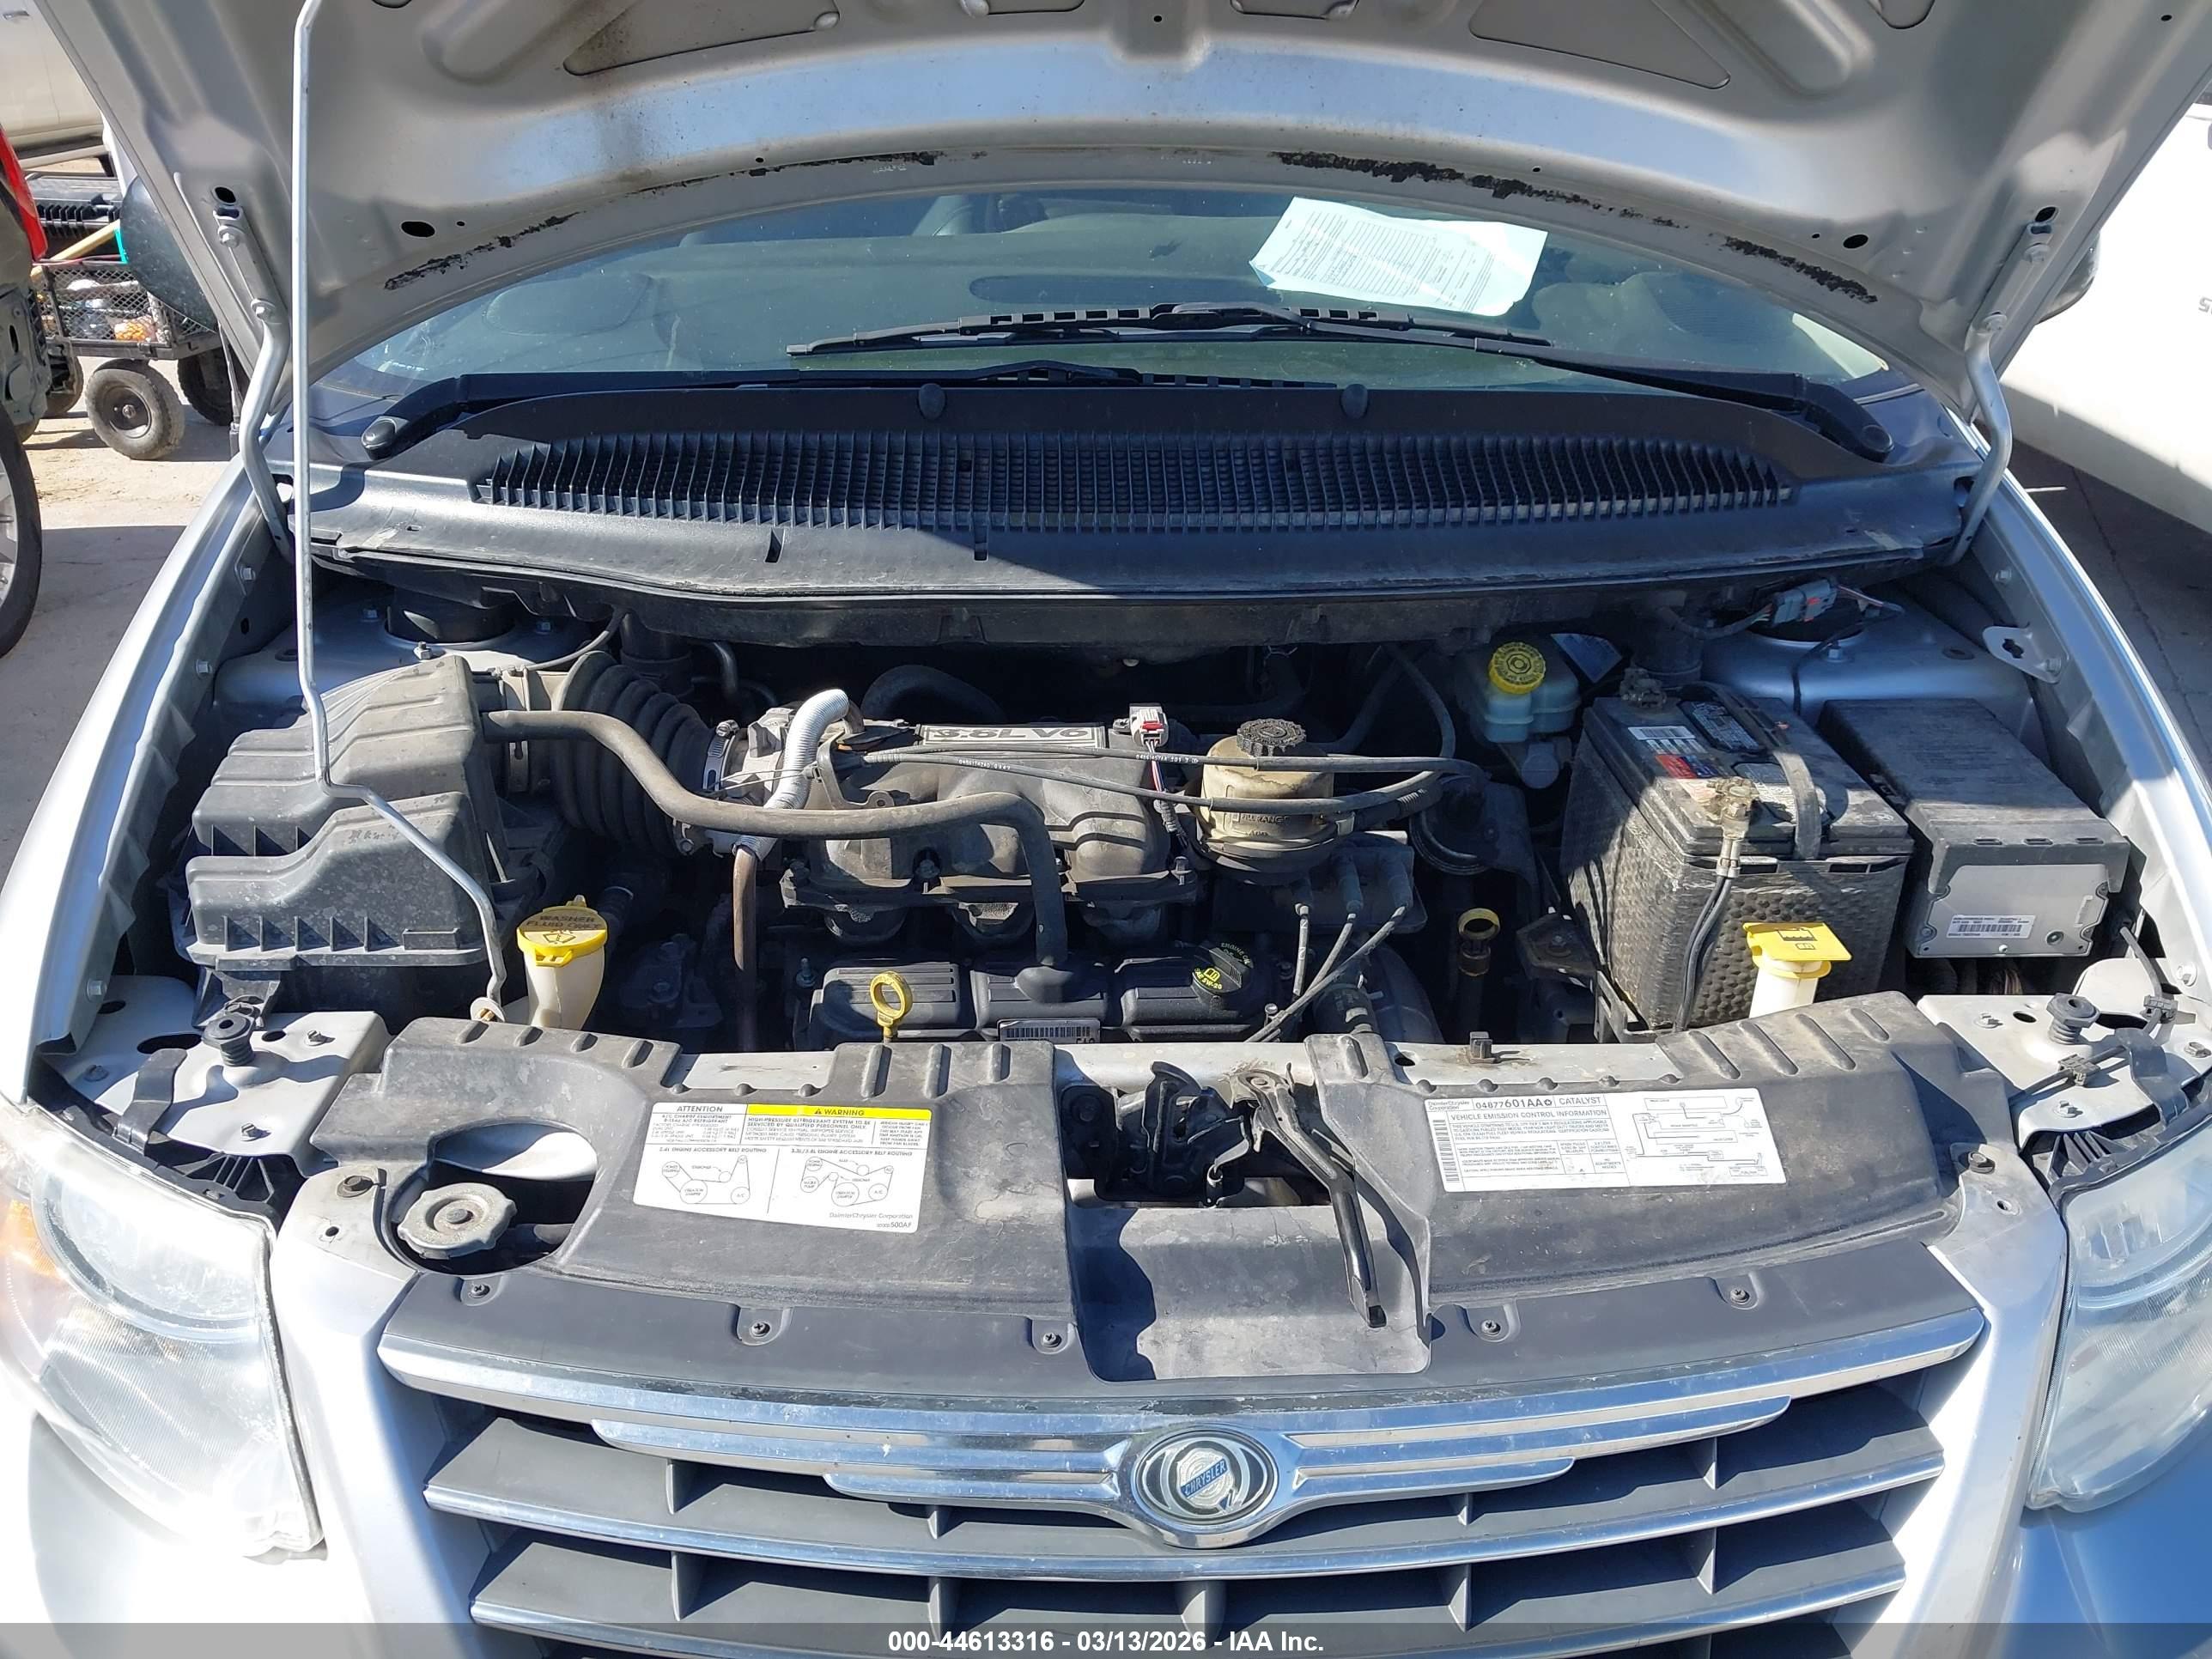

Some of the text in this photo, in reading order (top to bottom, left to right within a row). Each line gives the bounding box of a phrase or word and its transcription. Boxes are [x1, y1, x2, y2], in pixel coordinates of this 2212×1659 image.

[1031, 728, 1089, 738] V6
[1221, 942, 1244, 956] ENGINE
[1559, 1097, 1601, 1105] CATALYST
[824, 1108, 865, 1116] WARNING
[1520, 1110, 1555, 1119] CONTROL
[830, 1212, 877, 1220] DaimlerChrysler
[1184, 1460, 1226, 1496] CHRYSLER
